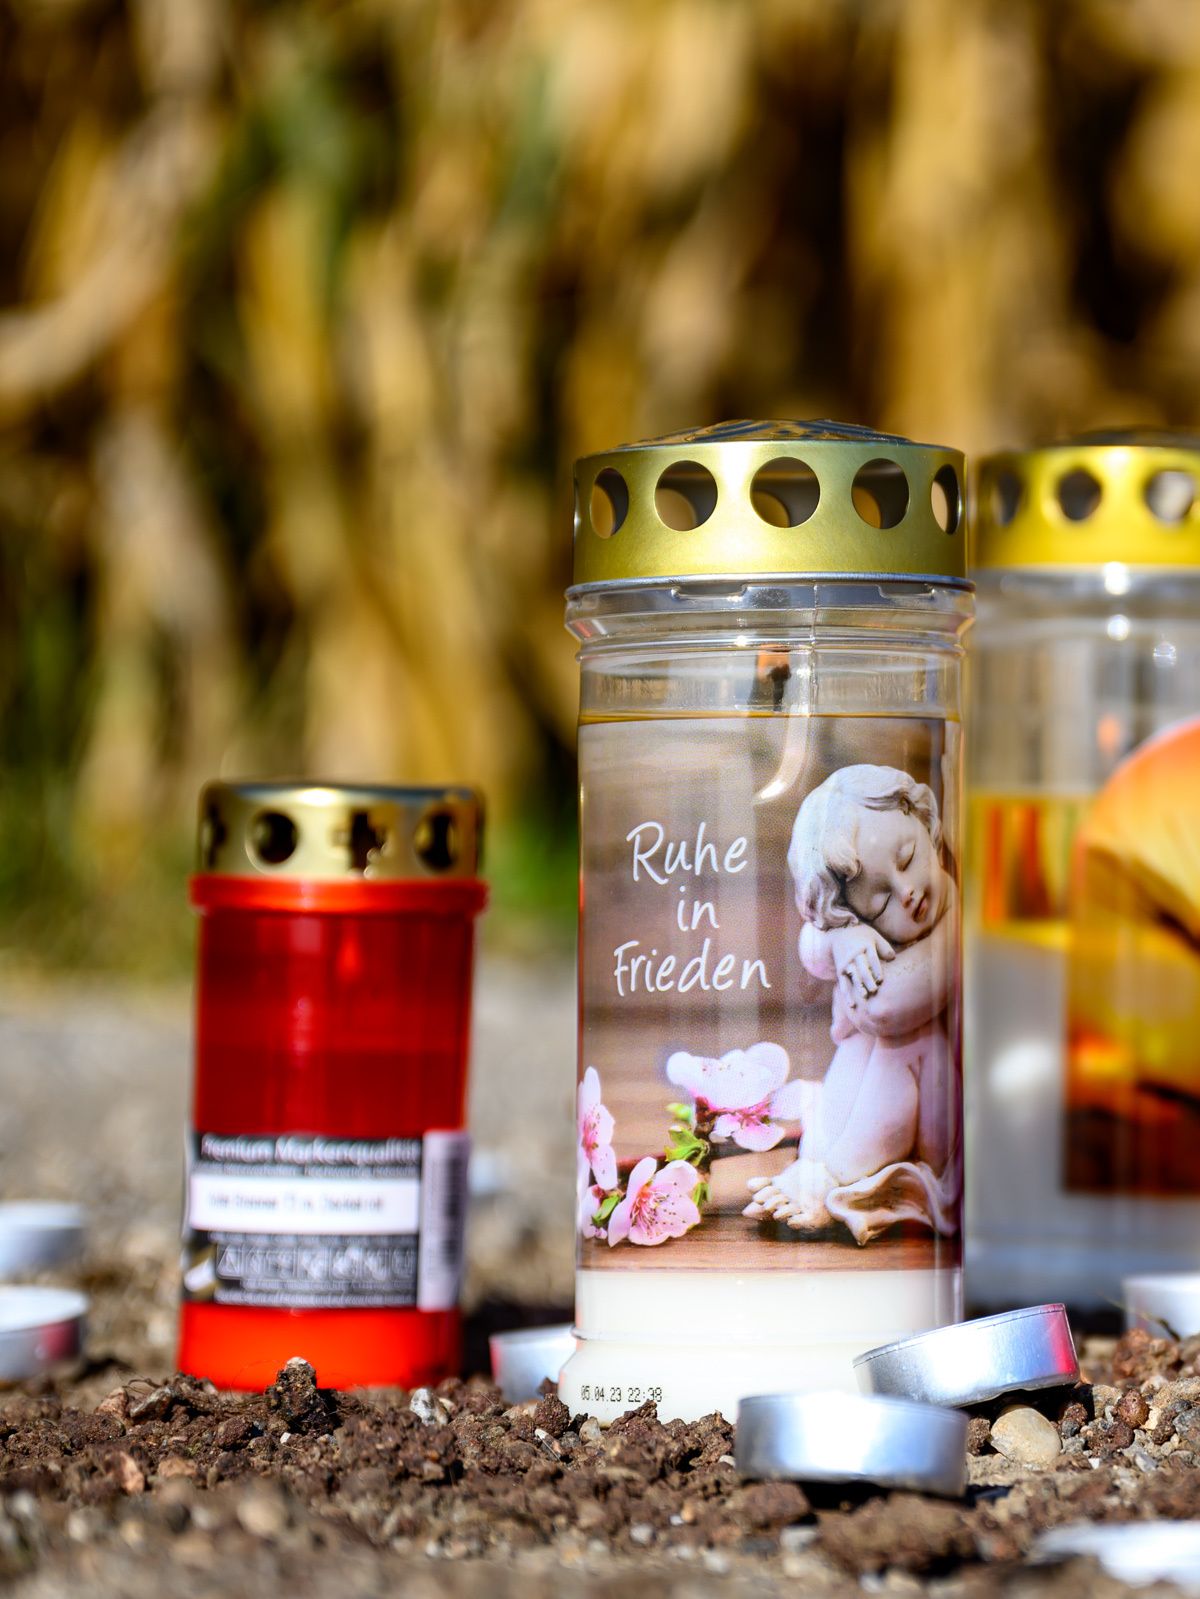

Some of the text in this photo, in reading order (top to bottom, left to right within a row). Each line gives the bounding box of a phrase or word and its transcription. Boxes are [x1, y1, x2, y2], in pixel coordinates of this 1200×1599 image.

[626, 821, 748, 885] Ruhe
[677, 885, 719, 932] in
[613, 938, 771, 997] Frieden
[581, 1385, 622, 1402] 05.04.23
